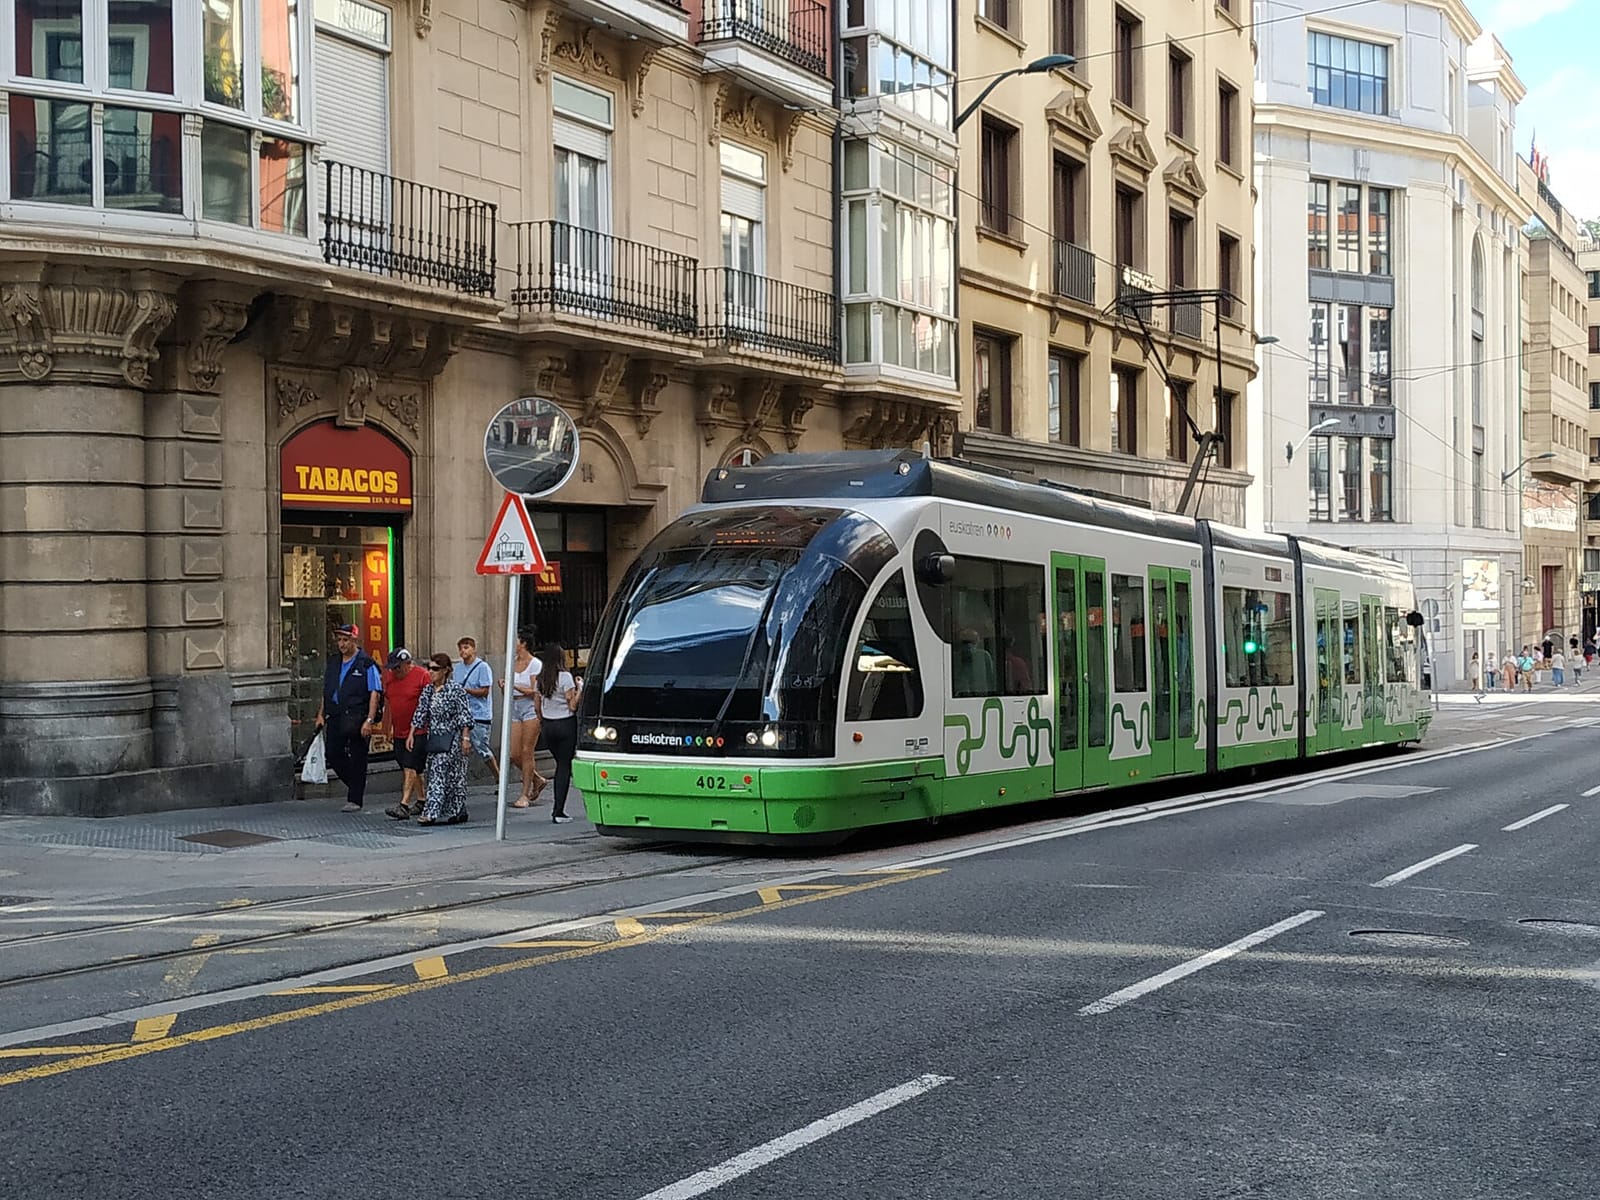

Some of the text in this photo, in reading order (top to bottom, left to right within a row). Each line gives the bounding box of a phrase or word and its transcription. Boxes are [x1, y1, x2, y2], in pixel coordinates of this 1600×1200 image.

[295, 465, 398, 494] TABACOS
[949, 520, 985, 537] euskotren
[631, 732, 683, 746] euskotren
[696, 775, 725, 790] 402
